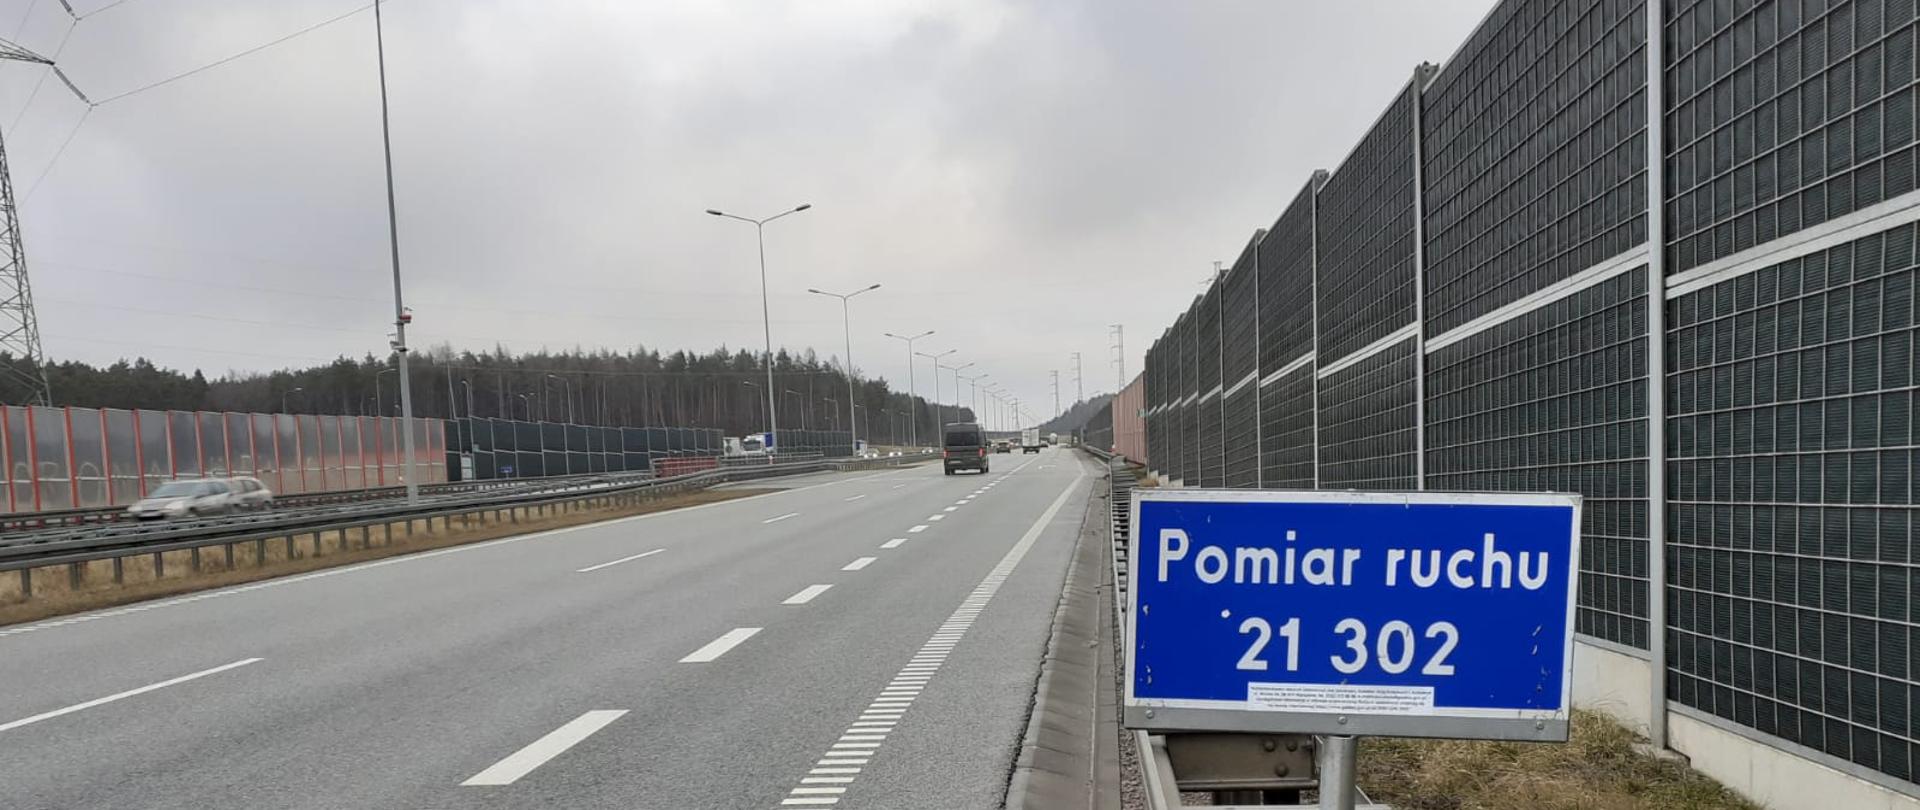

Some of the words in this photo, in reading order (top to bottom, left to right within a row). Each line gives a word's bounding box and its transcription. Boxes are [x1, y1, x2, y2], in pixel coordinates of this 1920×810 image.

[1158, 528, 1361, 586] Pomiar
[1386, 533, 1549, 590] ruchu
[1236, 617, 1300, 671] 21
[1330, 618, 1460, 676] 302
